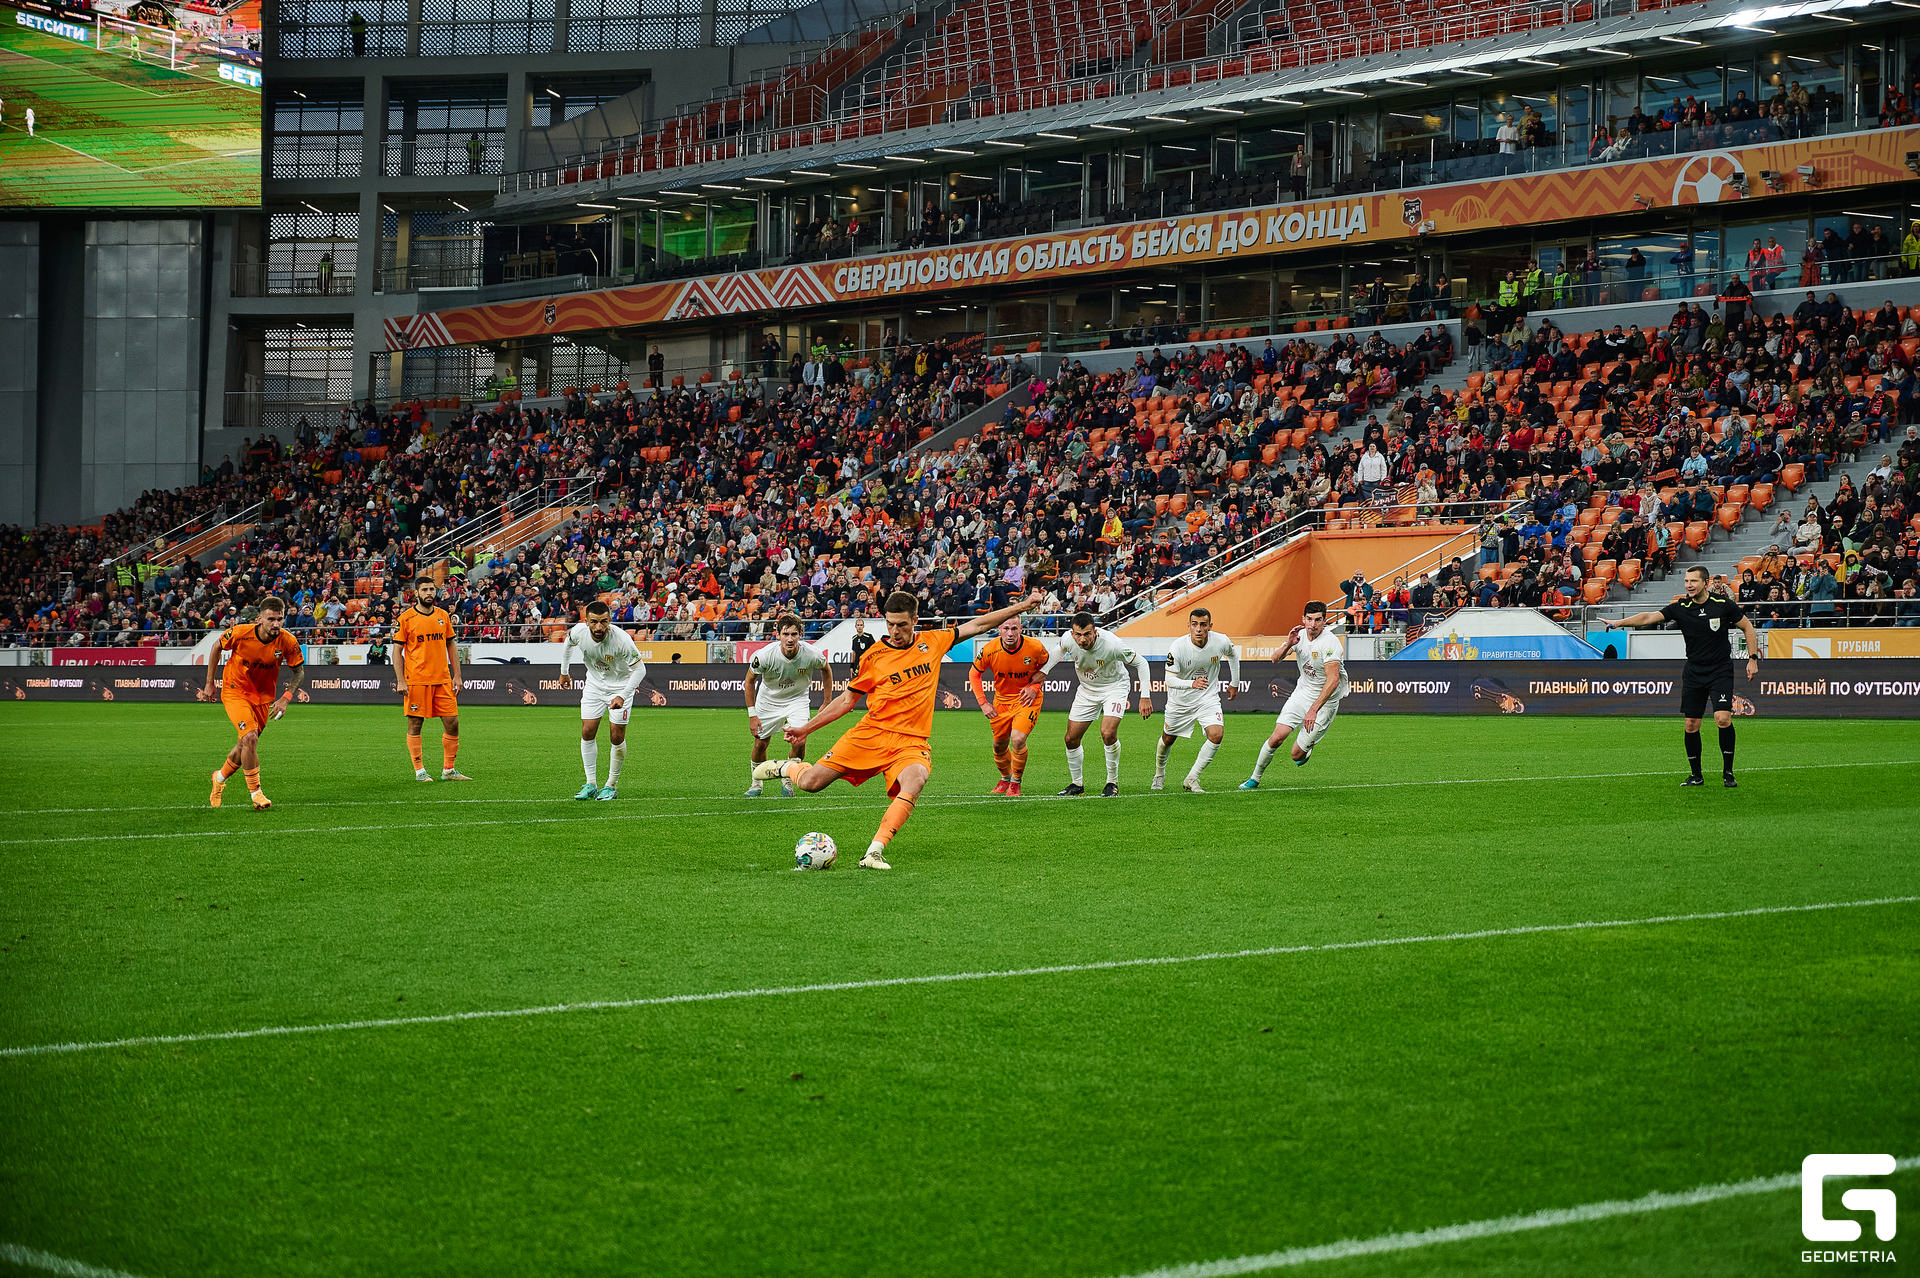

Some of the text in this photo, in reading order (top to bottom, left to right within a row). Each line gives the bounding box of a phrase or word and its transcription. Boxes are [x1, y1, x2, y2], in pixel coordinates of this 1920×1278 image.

[16, 11, 85, 41] БЕТСИТИ
[217, 63, 262, 87] БЕТ
[834, 205, 1368, 294] СВЕРДЛОВСКАЯ ОБЛАСТЬ БЕЙСЯ ДО КОНЦА
[1837, 640, 1881, 652] ТРУБНАЯ
[1246, 647, 1279, 658] ТРУБНА
[1481, 650, 1541, 659] ПРАВИТЕЛЬСТВО
[26, 678, 83, 688] ГЛАВНЫЙ ПО ФУТБОЛУ
[114, 678, 175, 688] ГЛАВНЫЙ ПО ФУТБОЛУ
[311, 678, 380, 690] ГЛАВНЫЙ ПО ФУТБОЛУ
[463, 680, 495, 690] ФУТБОЛУ
[574, 680, 585, 690] ПО
[668, 678, 706, 691] ГЛАВНЫЙ
[708, 681, 719, 691] ПО
[810, 678, 851, 691] ГЛАНЫЙ
[1376, 681, 1393, 694] ПО
[1395, 681, 1451, 694] ФУТБОЛУ
[1529, 678, 1673, 695] ГЛАВНЫЙ ПО ФУТБОЛУ
[1760, 678, 1920, 695] ГЛАВНЫЙ ПО ФУТБОЛУ
[1111, 702, 1122, 714] 70
[622, 709, 628, 720] 8
